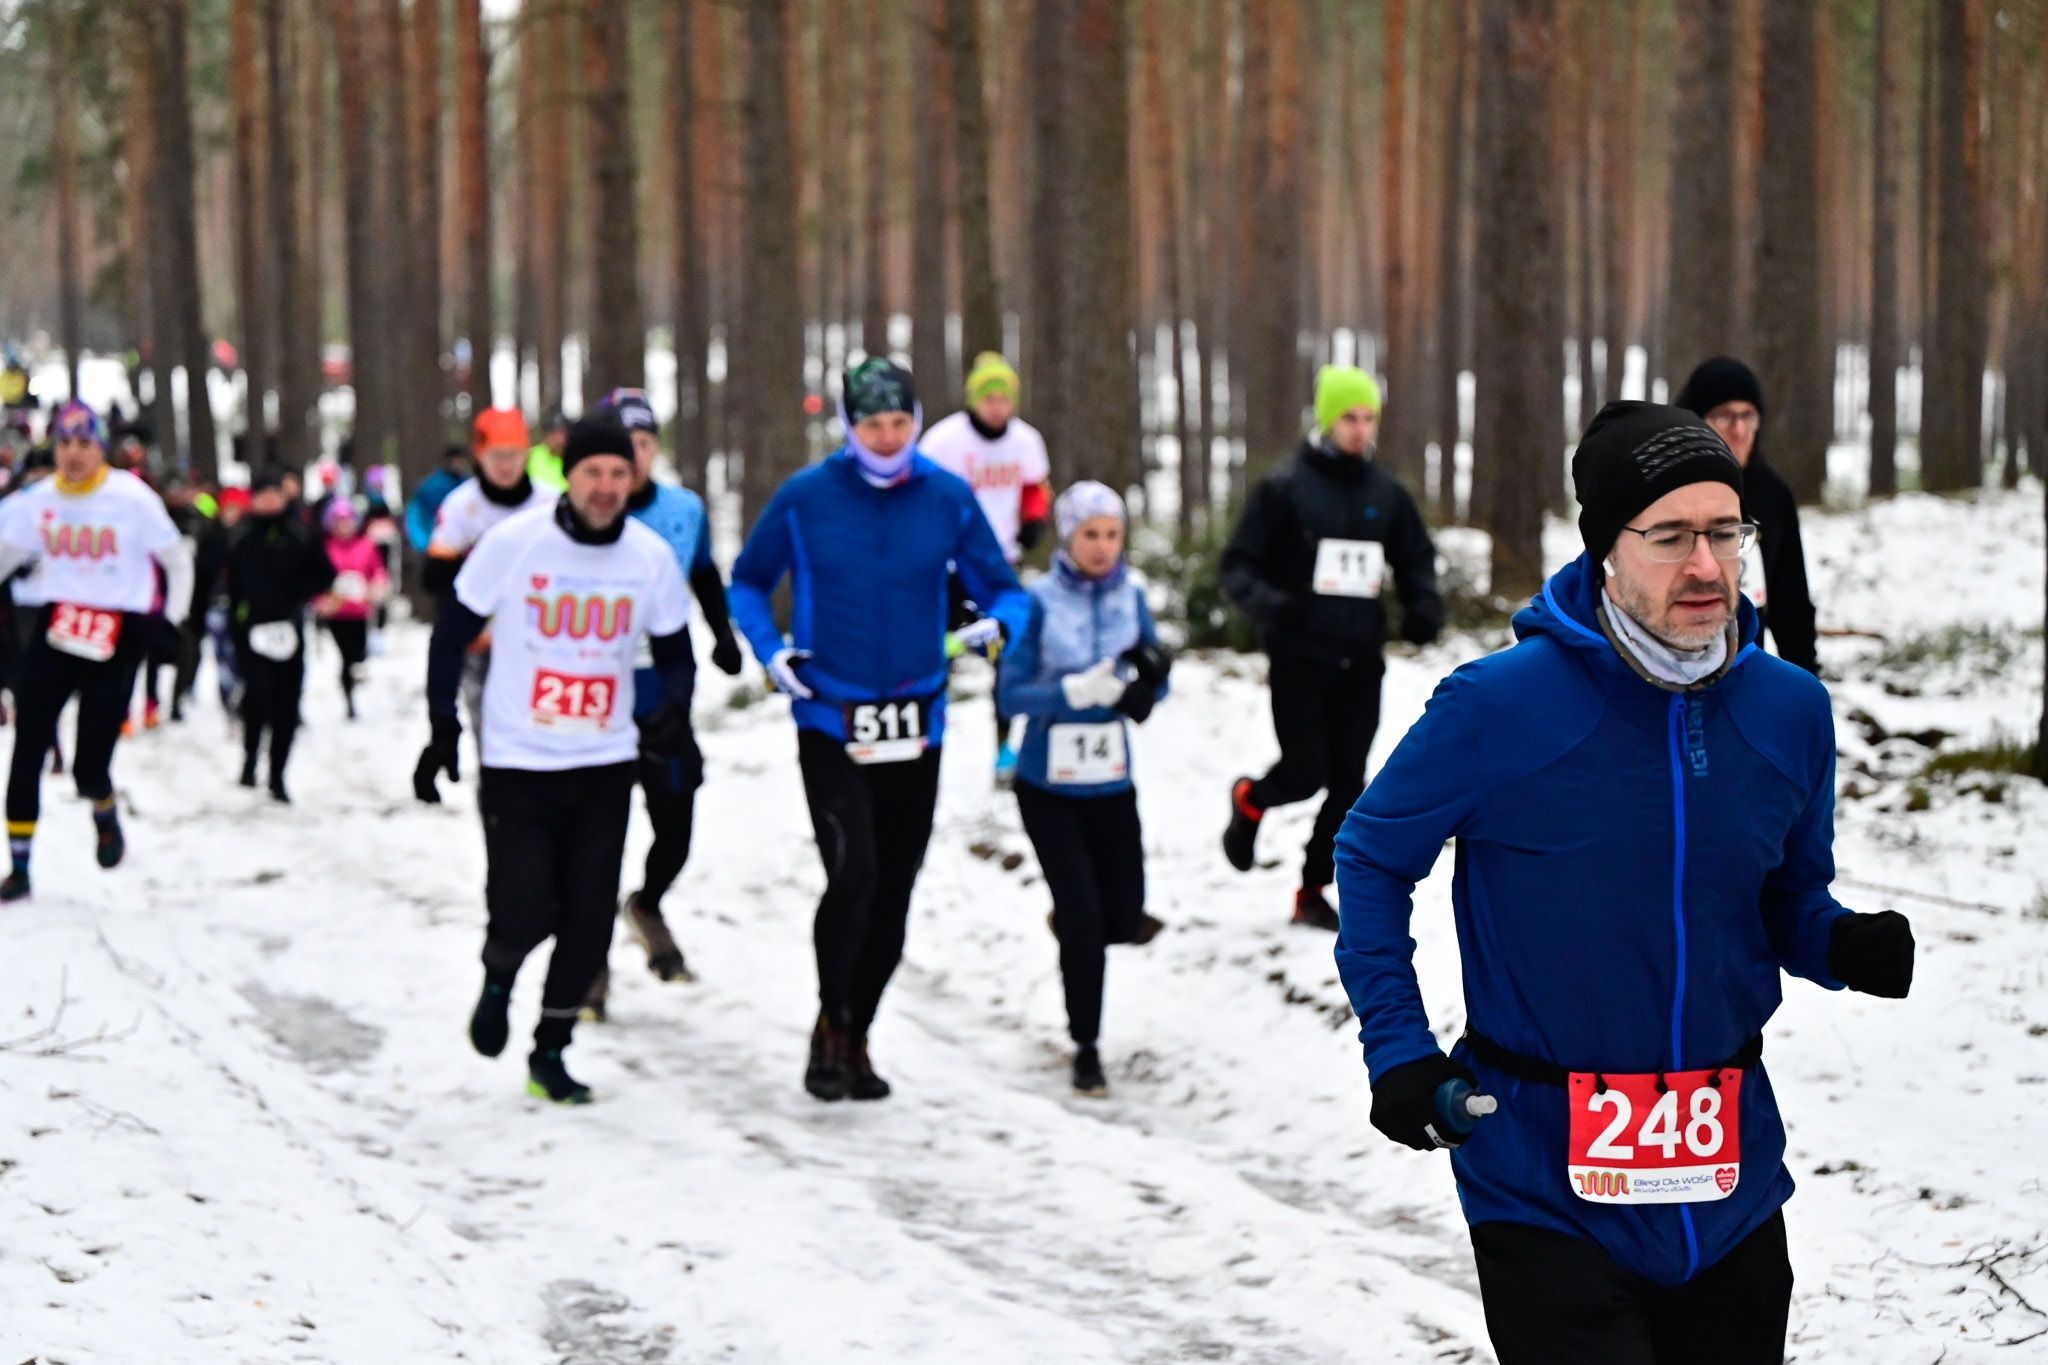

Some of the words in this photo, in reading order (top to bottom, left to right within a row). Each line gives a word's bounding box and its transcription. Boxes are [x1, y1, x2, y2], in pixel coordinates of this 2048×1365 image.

[1340, 550, 1366, 577] 11
[53, 603, 115, 641] 212
[536, 676, 609, 716] 213
[853, 701, 920, 743] 511
[1074, 735, 1109, 762] 14
[1586, 1086, 1724, 1160] 248
[1662, 1178, 1680, 1186] Dla
